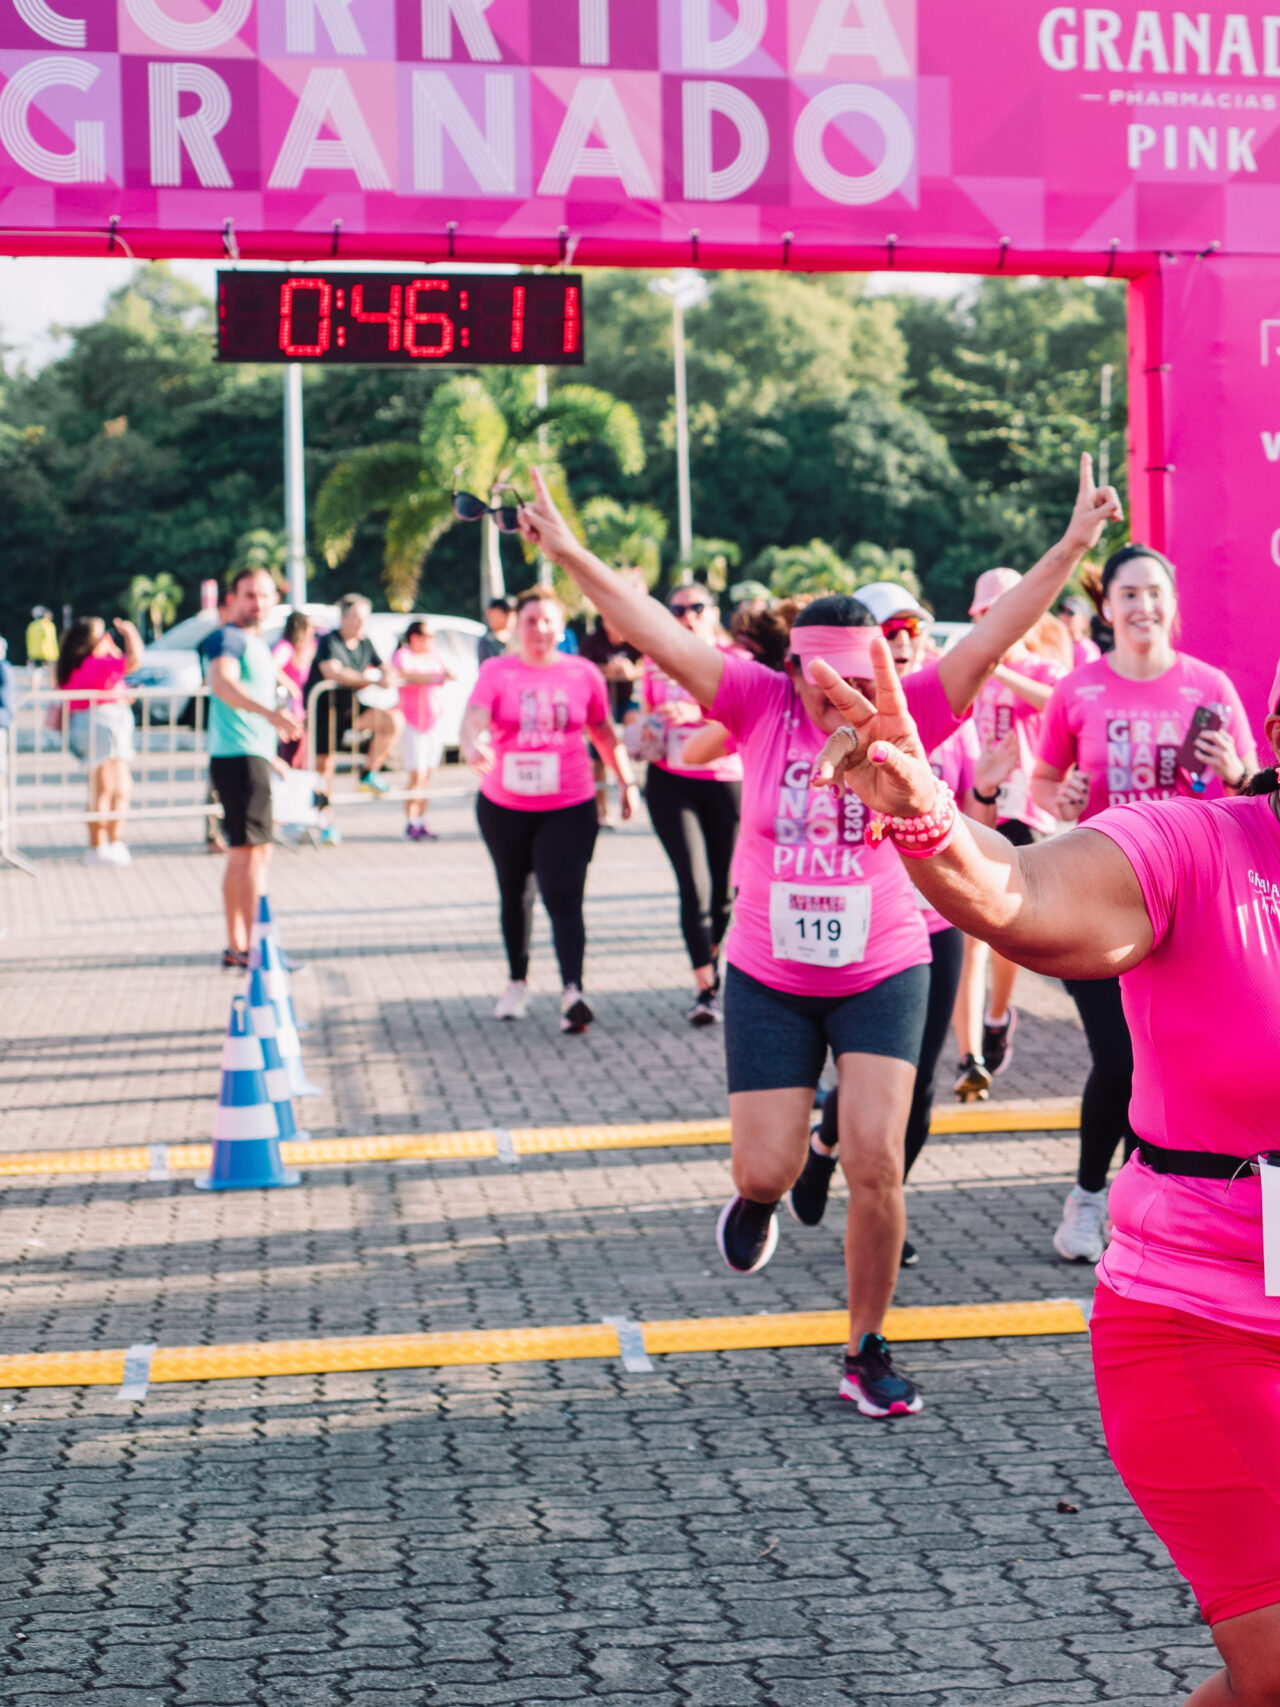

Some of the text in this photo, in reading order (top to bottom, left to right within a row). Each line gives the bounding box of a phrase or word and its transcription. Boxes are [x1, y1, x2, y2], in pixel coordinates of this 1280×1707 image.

[1108, 88, 1277, 111] PHARMÁCIAS
[0, 55, 915, 206] GRANADO
[1127, 124, 1258, 172] PINK
[280, 277, 579, 357] 0:46:11
[1107, 719, 1180, 744] GRA
[1108, 742, 1154, 767] NA
[1108, 767, 1156, 791] DO
[776, 787, 837, 820] NA
[775, 818, 839, 846] DO
[773, 845, 866, 878] PINK
[795, 917, 841, 942] 119
